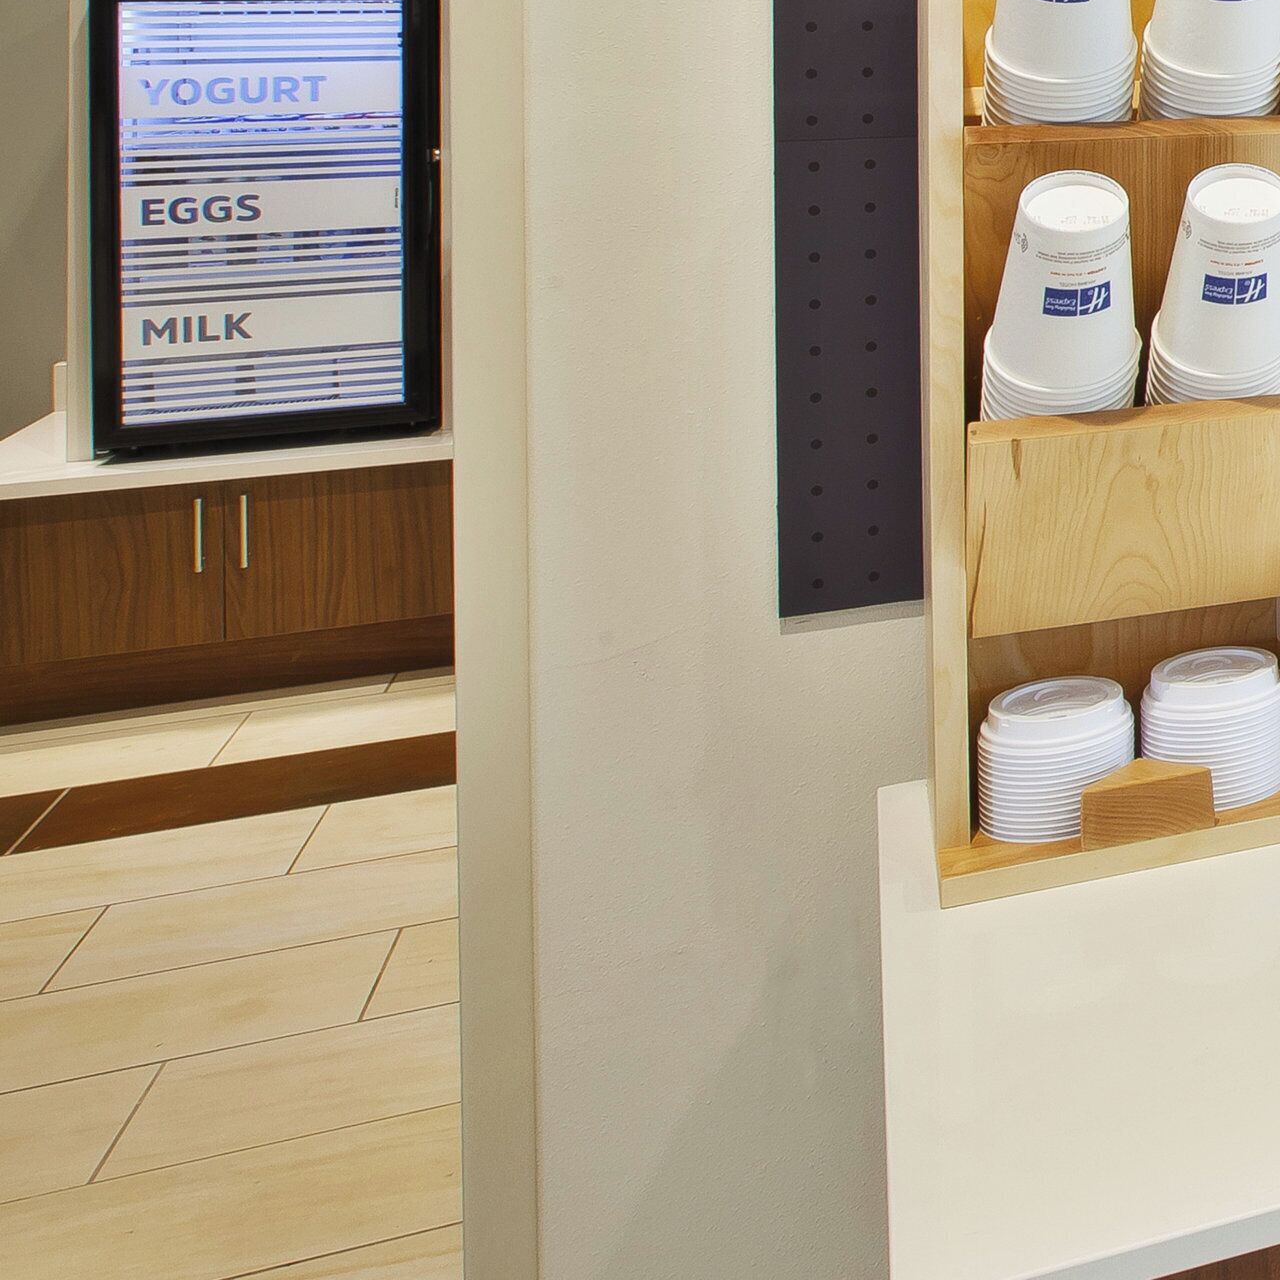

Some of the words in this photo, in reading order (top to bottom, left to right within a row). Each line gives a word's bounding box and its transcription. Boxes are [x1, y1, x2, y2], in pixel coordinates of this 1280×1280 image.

[138, 75, 327, 106] YOGURT
[140, 194, 262, 226] EGGS
[141, 311, 253, 346] MILK
